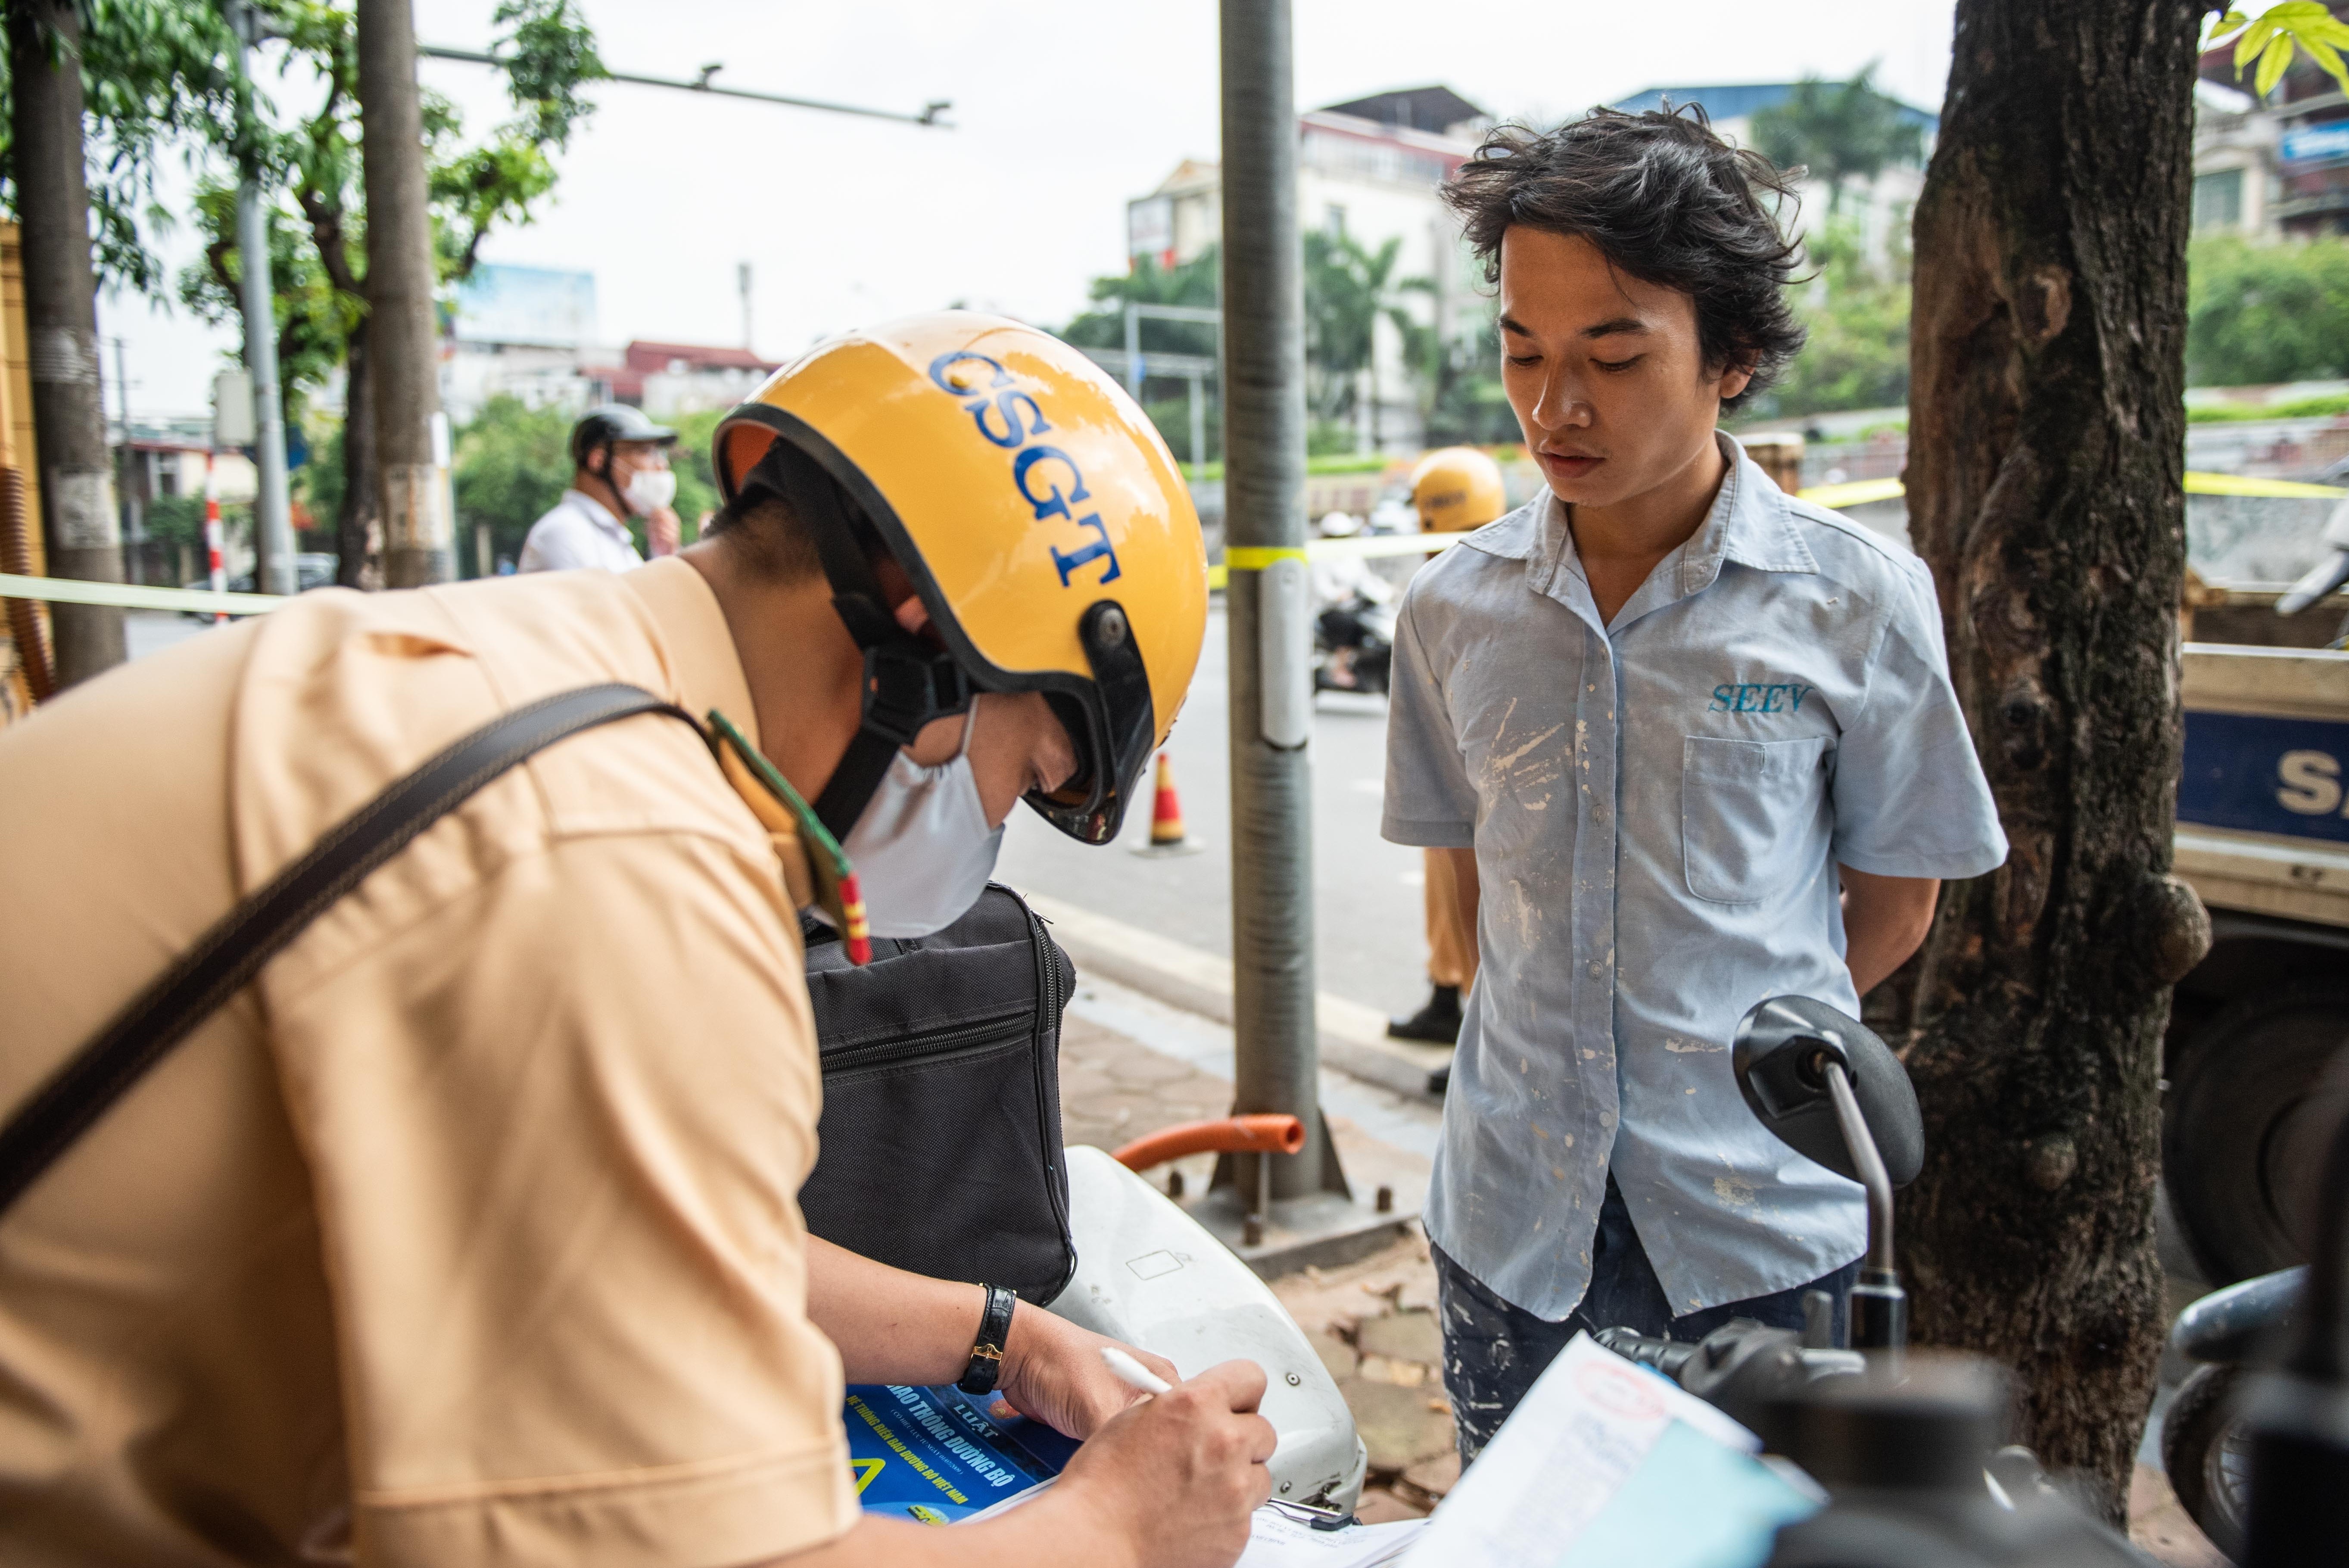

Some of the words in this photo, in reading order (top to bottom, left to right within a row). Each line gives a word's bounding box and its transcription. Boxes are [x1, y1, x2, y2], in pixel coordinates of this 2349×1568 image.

[928, 351, 1122, 588] CSGT
[2276, 749, 2349, 818] S
[854, 1402, 881, 1426] THỐNG
[945, 1488, 969, 1505] NAM
[885, 1385, 920, 1404] IAO
[908, 1400, 955, 1440] THÔNG
[943, 1436, 996, 1473] ĐƯỜNG
[984, 1468, 1015, 1487] BỘ
[953, 1403, 999, 1438] LUẬT
